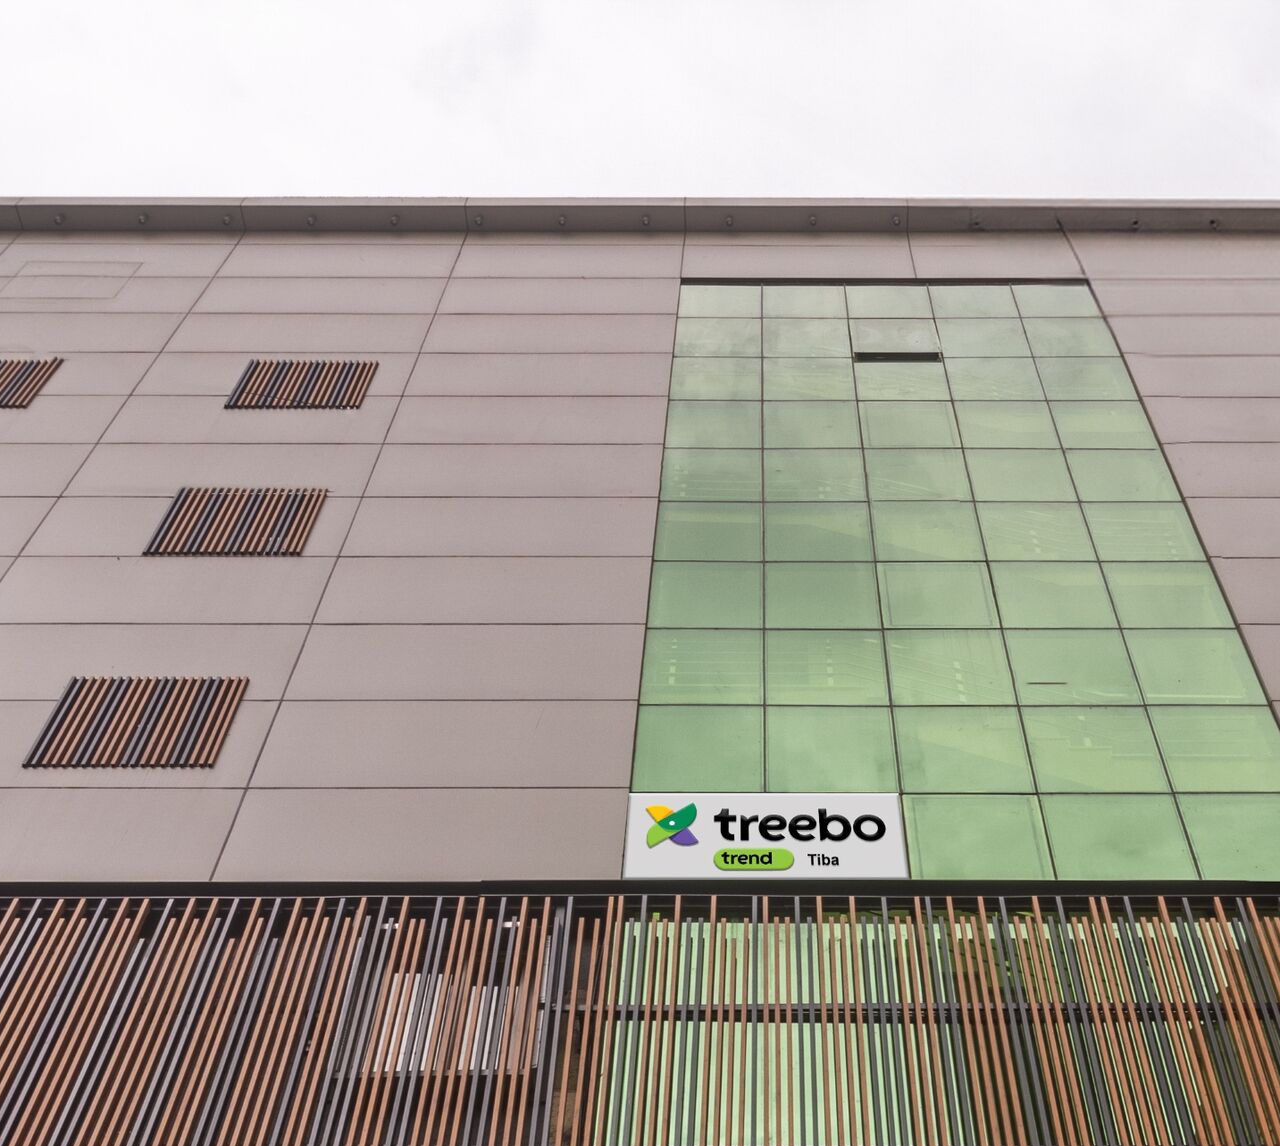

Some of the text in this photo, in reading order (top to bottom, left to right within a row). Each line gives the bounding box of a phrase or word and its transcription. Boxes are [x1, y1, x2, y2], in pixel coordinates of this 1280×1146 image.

[713, 808, 887, 842] treebo
[721, 851, 840, 867] trend Tiba
